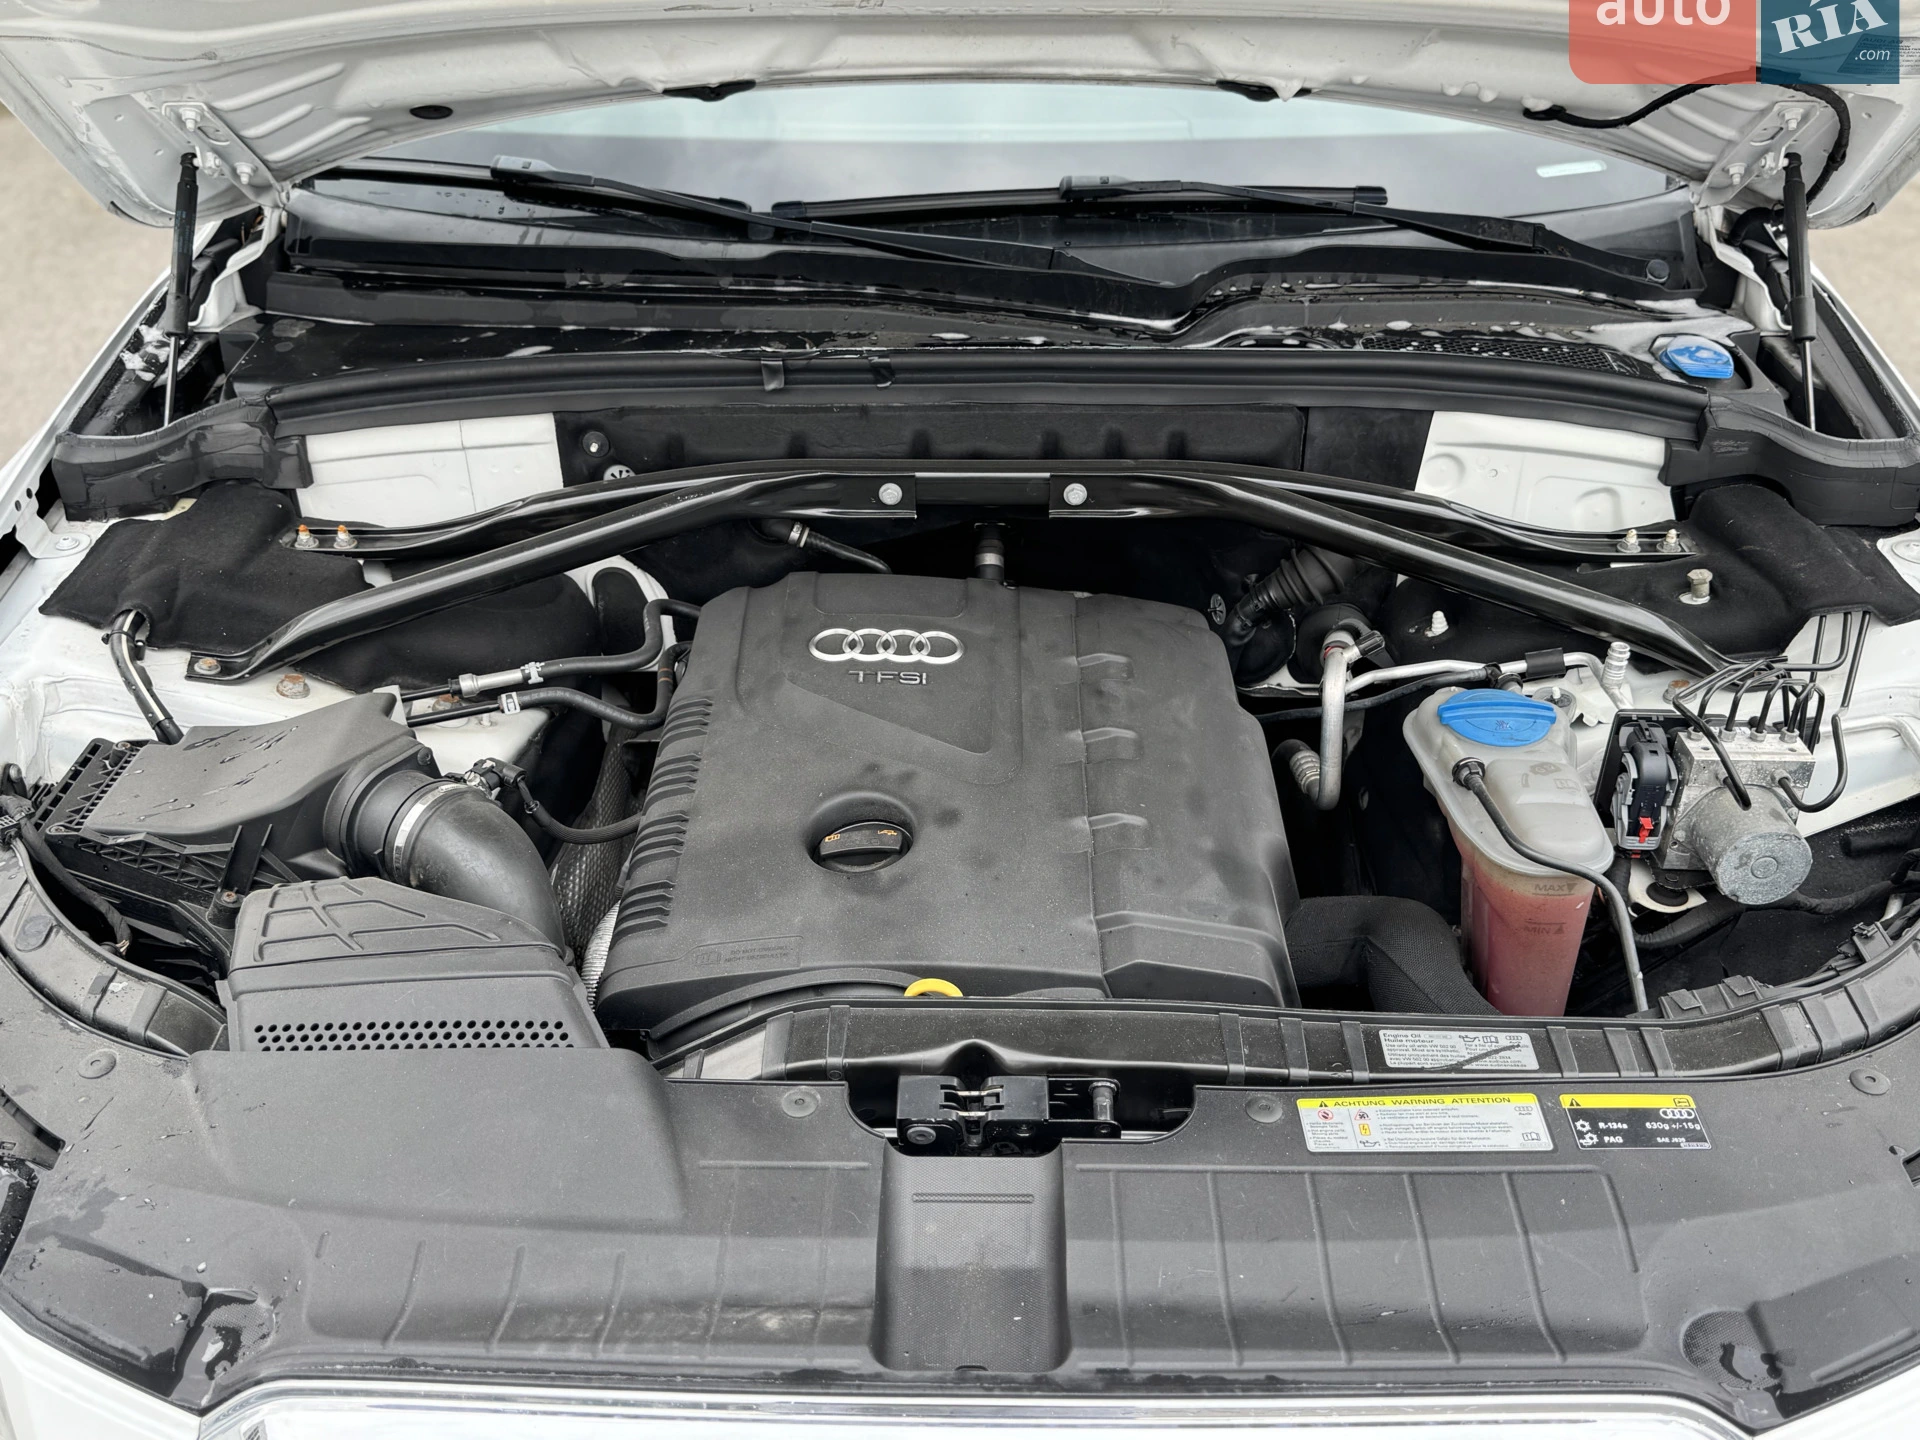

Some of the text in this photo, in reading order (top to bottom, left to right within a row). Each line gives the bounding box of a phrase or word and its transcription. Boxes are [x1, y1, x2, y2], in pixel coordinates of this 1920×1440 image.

[847, 669, 928, 686] TFSI
[1534, 883, 1566, 892] MAX
[1524, 925, 1551, 935] MIN
[1333, 1096, 1511, 1107] ACHTUNG WARNING ATTENTION
[1645, 1122, 1670, 1130] 630g
